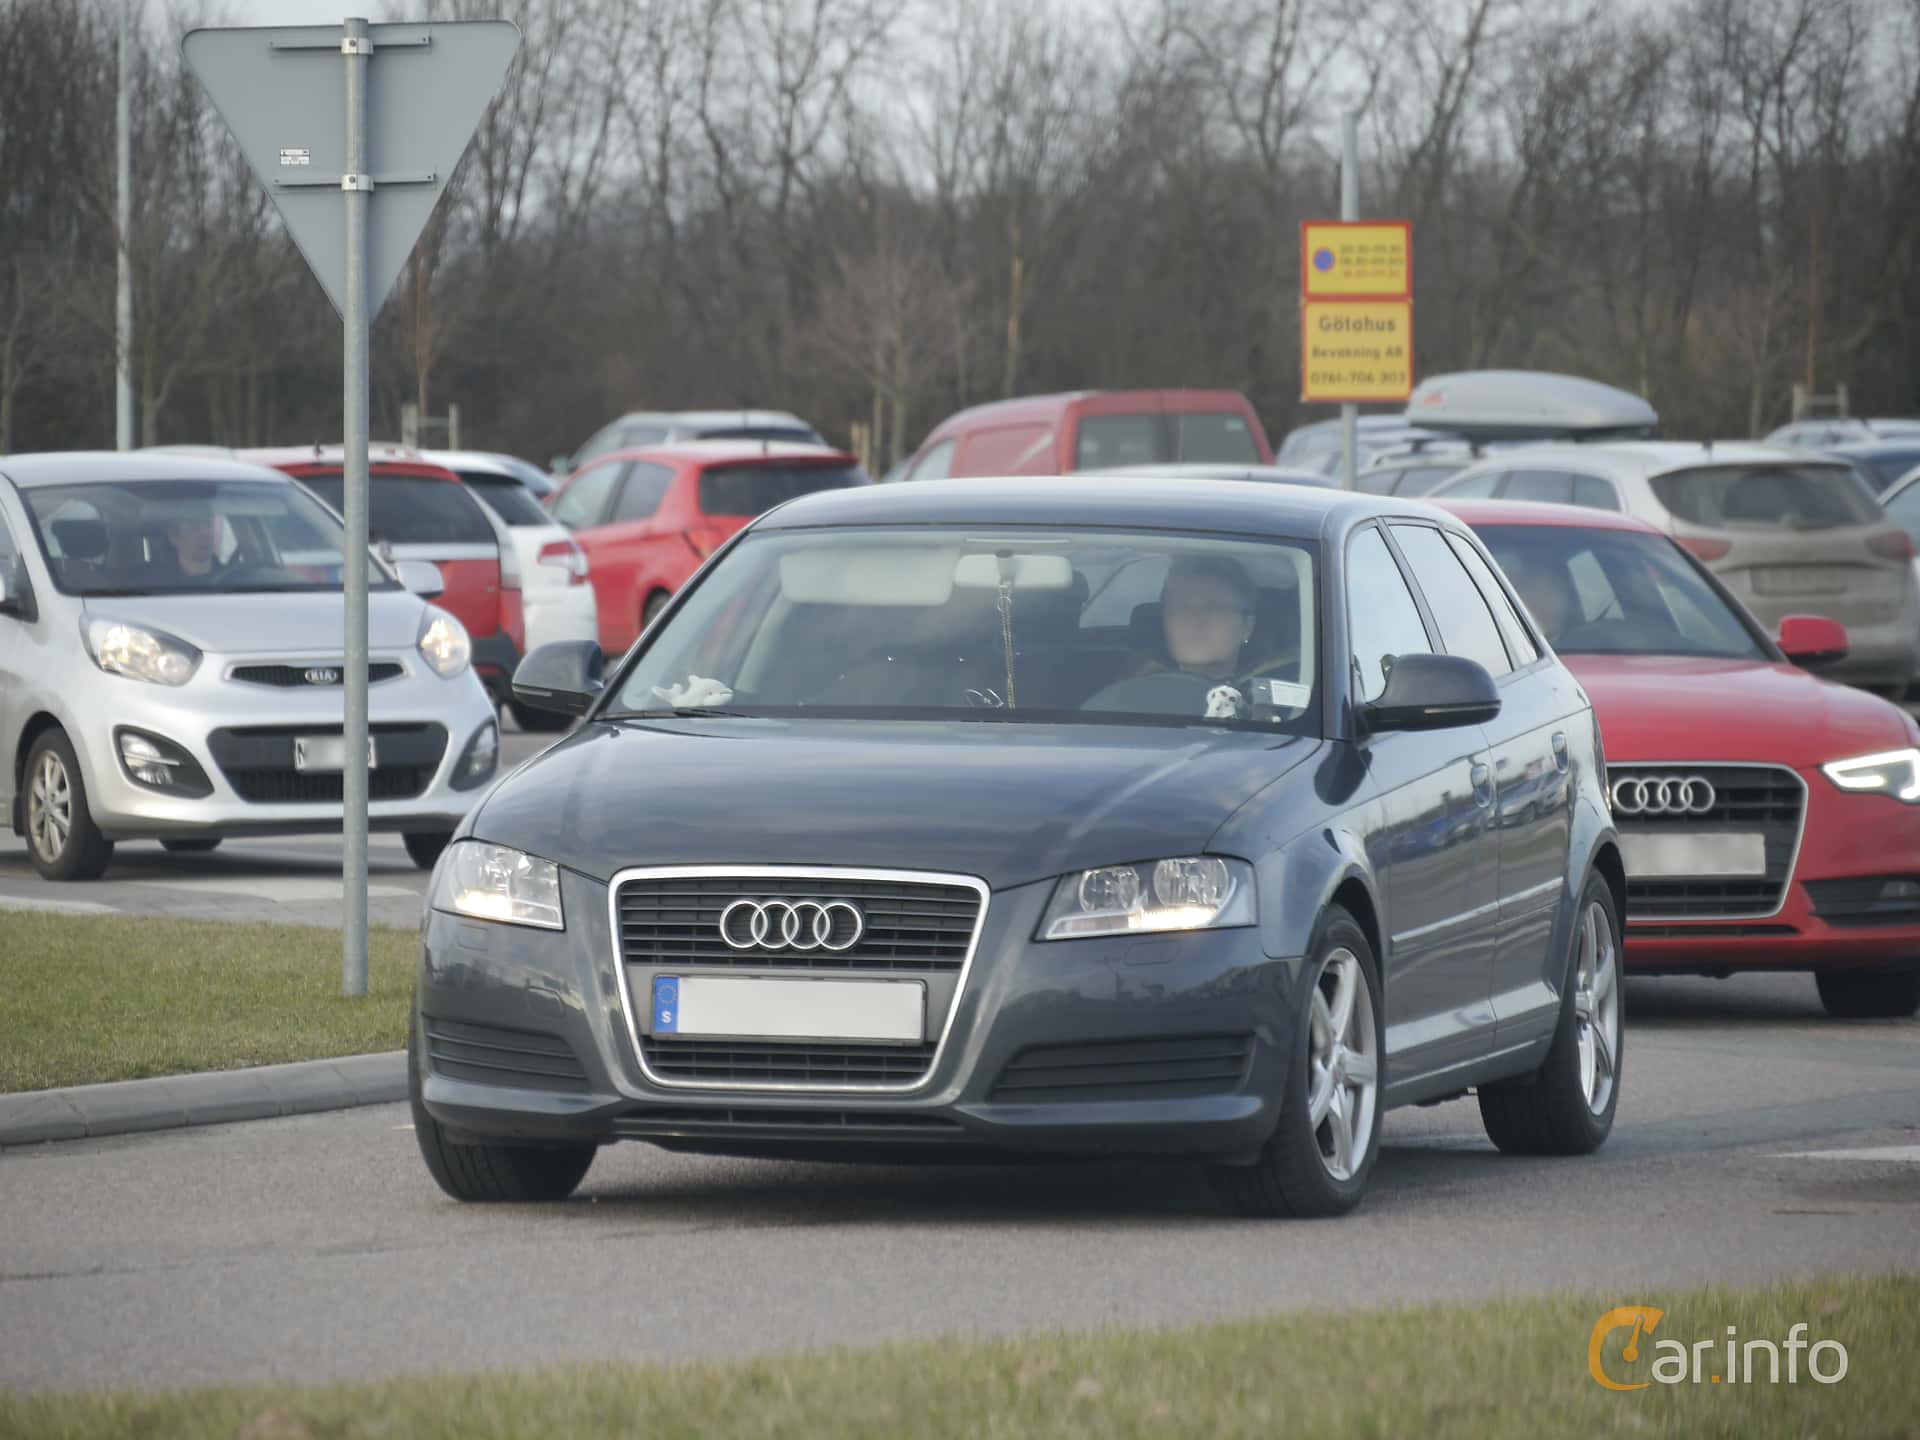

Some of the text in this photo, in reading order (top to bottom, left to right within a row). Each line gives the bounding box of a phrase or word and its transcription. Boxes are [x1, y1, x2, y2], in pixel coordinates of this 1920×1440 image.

[1319, 315, 1396, 332] Götahus
[1385, 346, 1403, 358] AB
[661, 1010, 672, 1024] S
